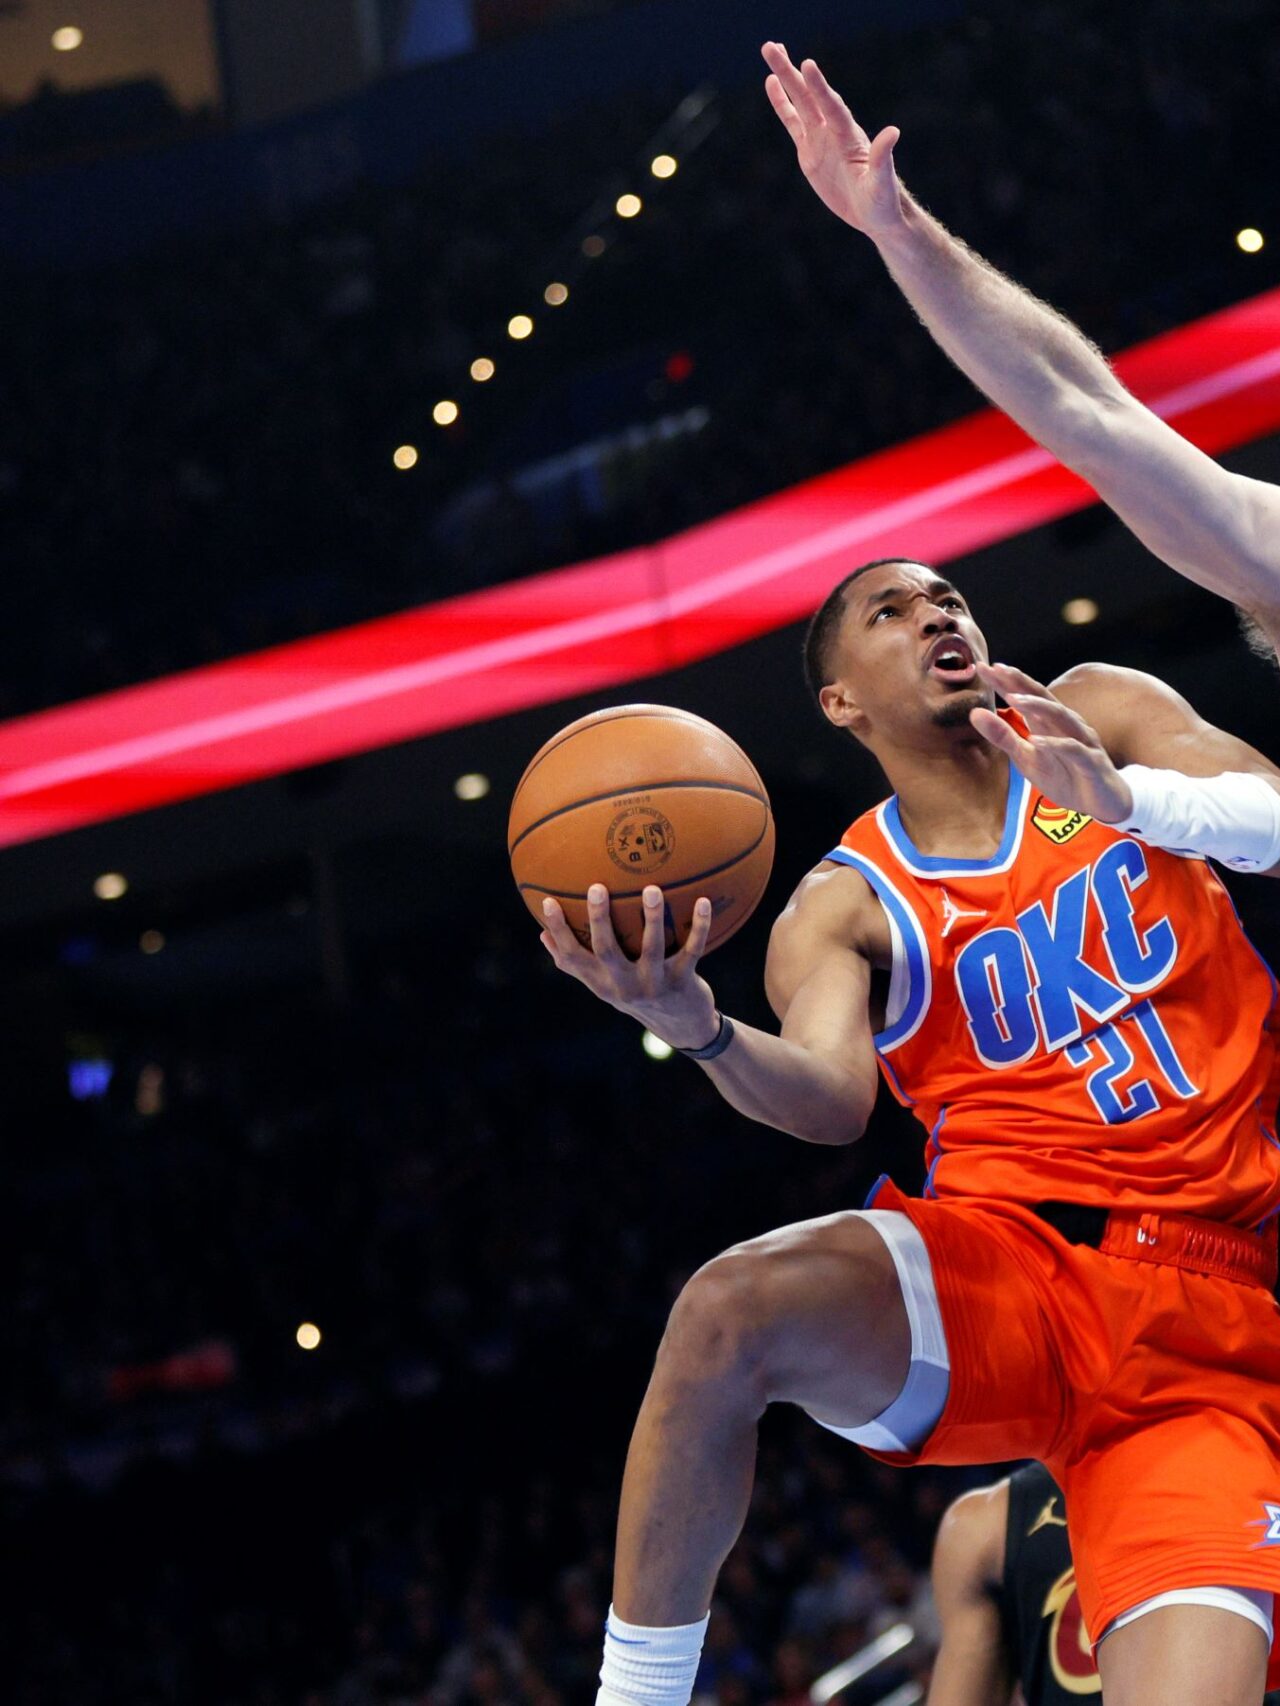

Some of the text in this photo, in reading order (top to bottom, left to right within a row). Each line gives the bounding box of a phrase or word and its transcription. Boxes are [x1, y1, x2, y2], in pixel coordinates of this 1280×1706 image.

[1050, 811, 1087, 840] Lov
[954, 838, 1178, 1070] OKC
[1064, 998, 1200, 1125] 21
